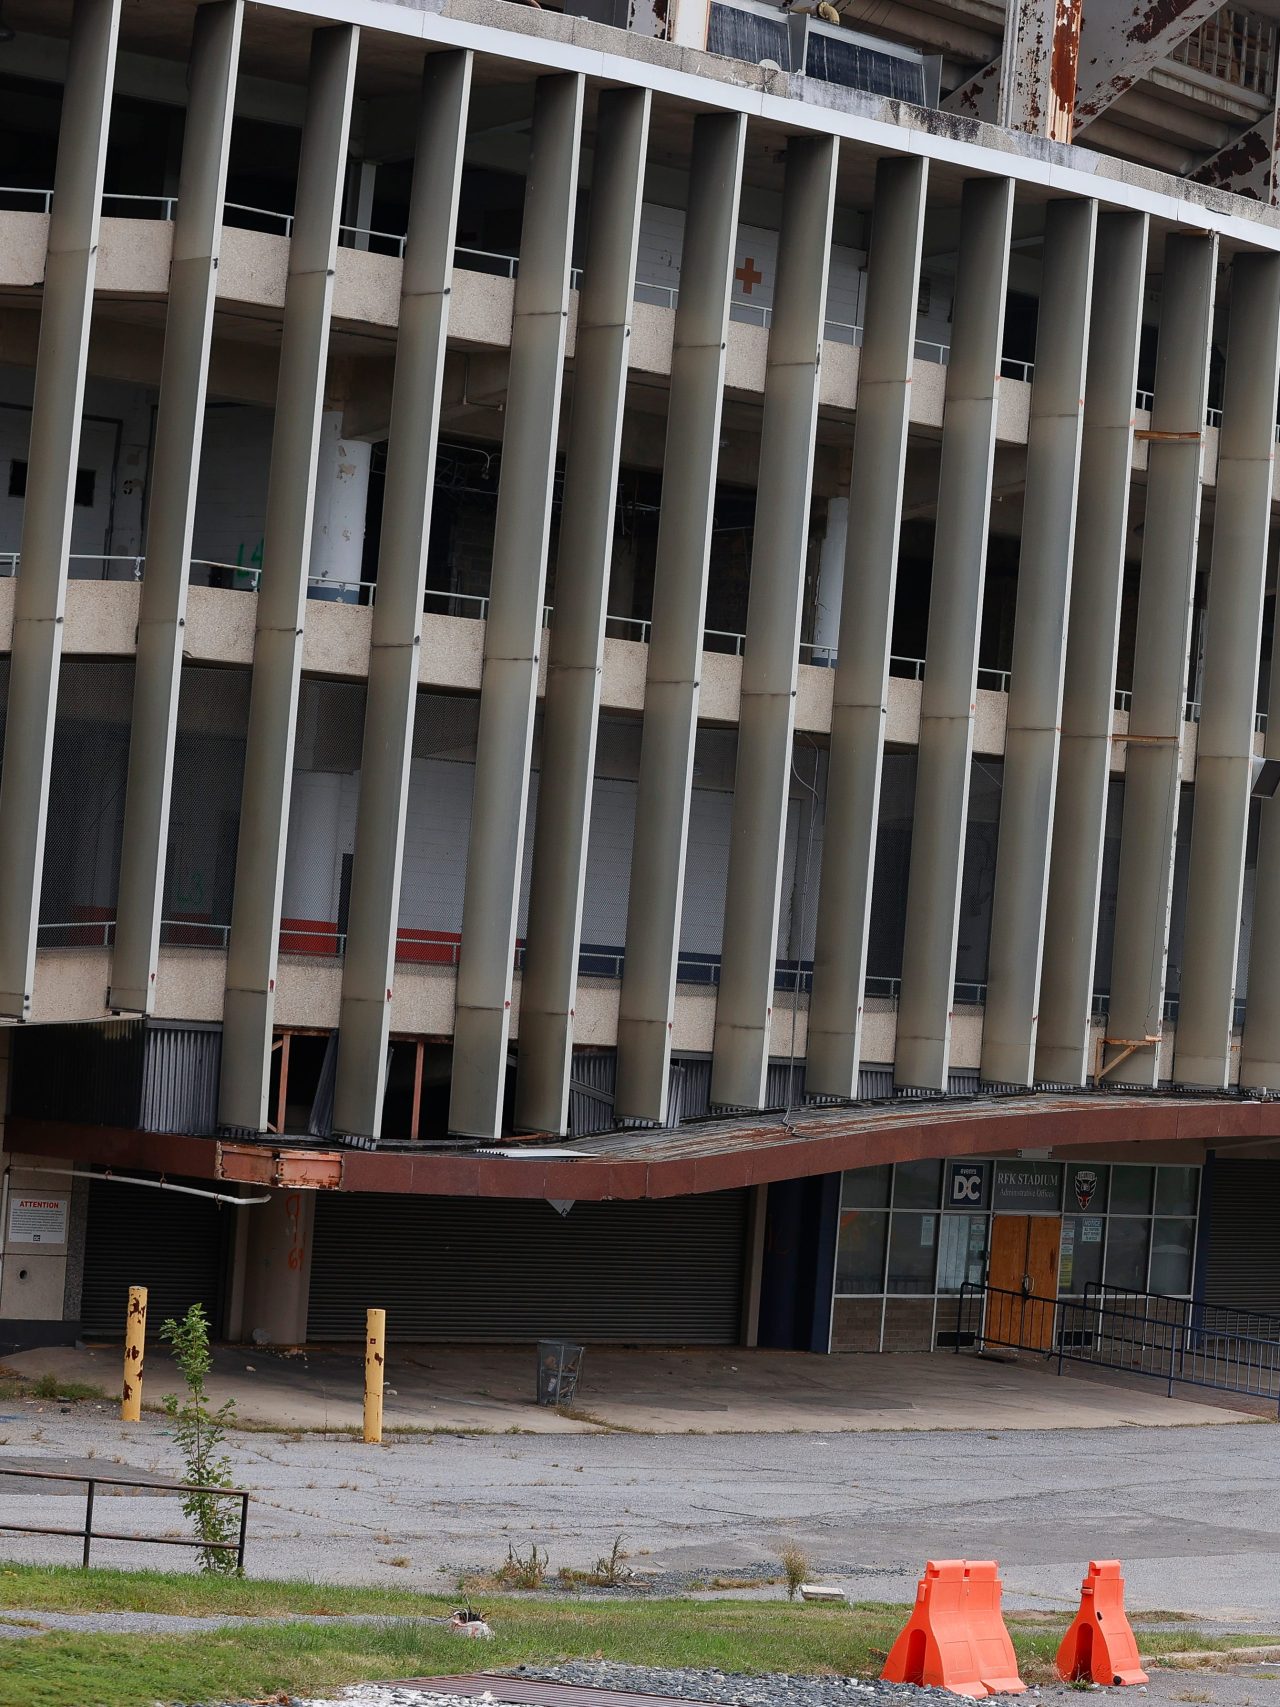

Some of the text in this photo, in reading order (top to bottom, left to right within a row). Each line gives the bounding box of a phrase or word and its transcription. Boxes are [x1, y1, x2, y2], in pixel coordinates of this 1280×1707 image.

[997, 1172, 1059, 1186] RFK STADIUM
[953, 1175, 981, 1200] DC
[19, 1200, 60, 1210] ATTENTION
